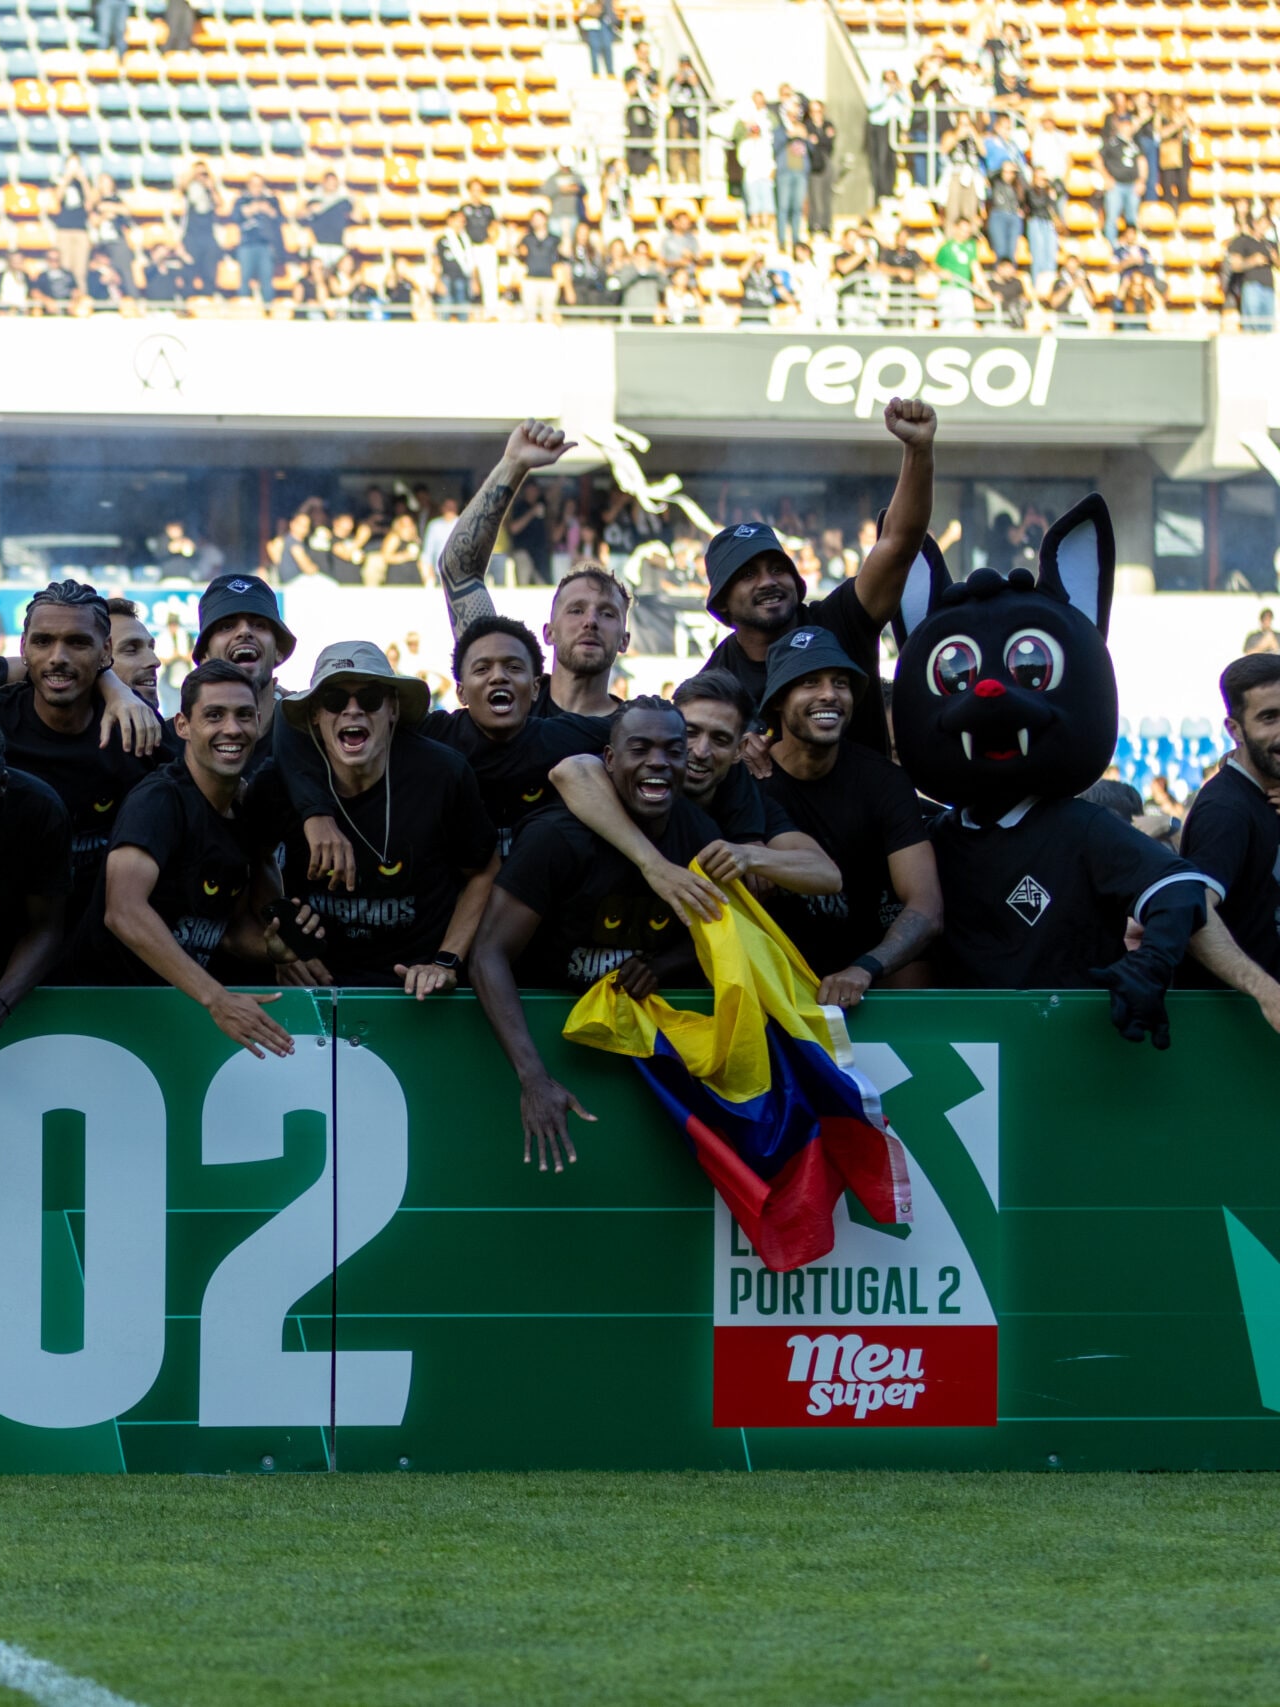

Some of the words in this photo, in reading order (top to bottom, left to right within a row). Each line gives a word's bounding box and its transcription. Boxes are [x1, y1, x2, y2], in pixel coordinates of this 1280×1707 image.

[766, 335, 1058, 418] repsol
[730, 1266, 928, 1316] PORTUGAL
[938, 1265, 961, 1315] 2
[806, 1382, 926, 1419] super
